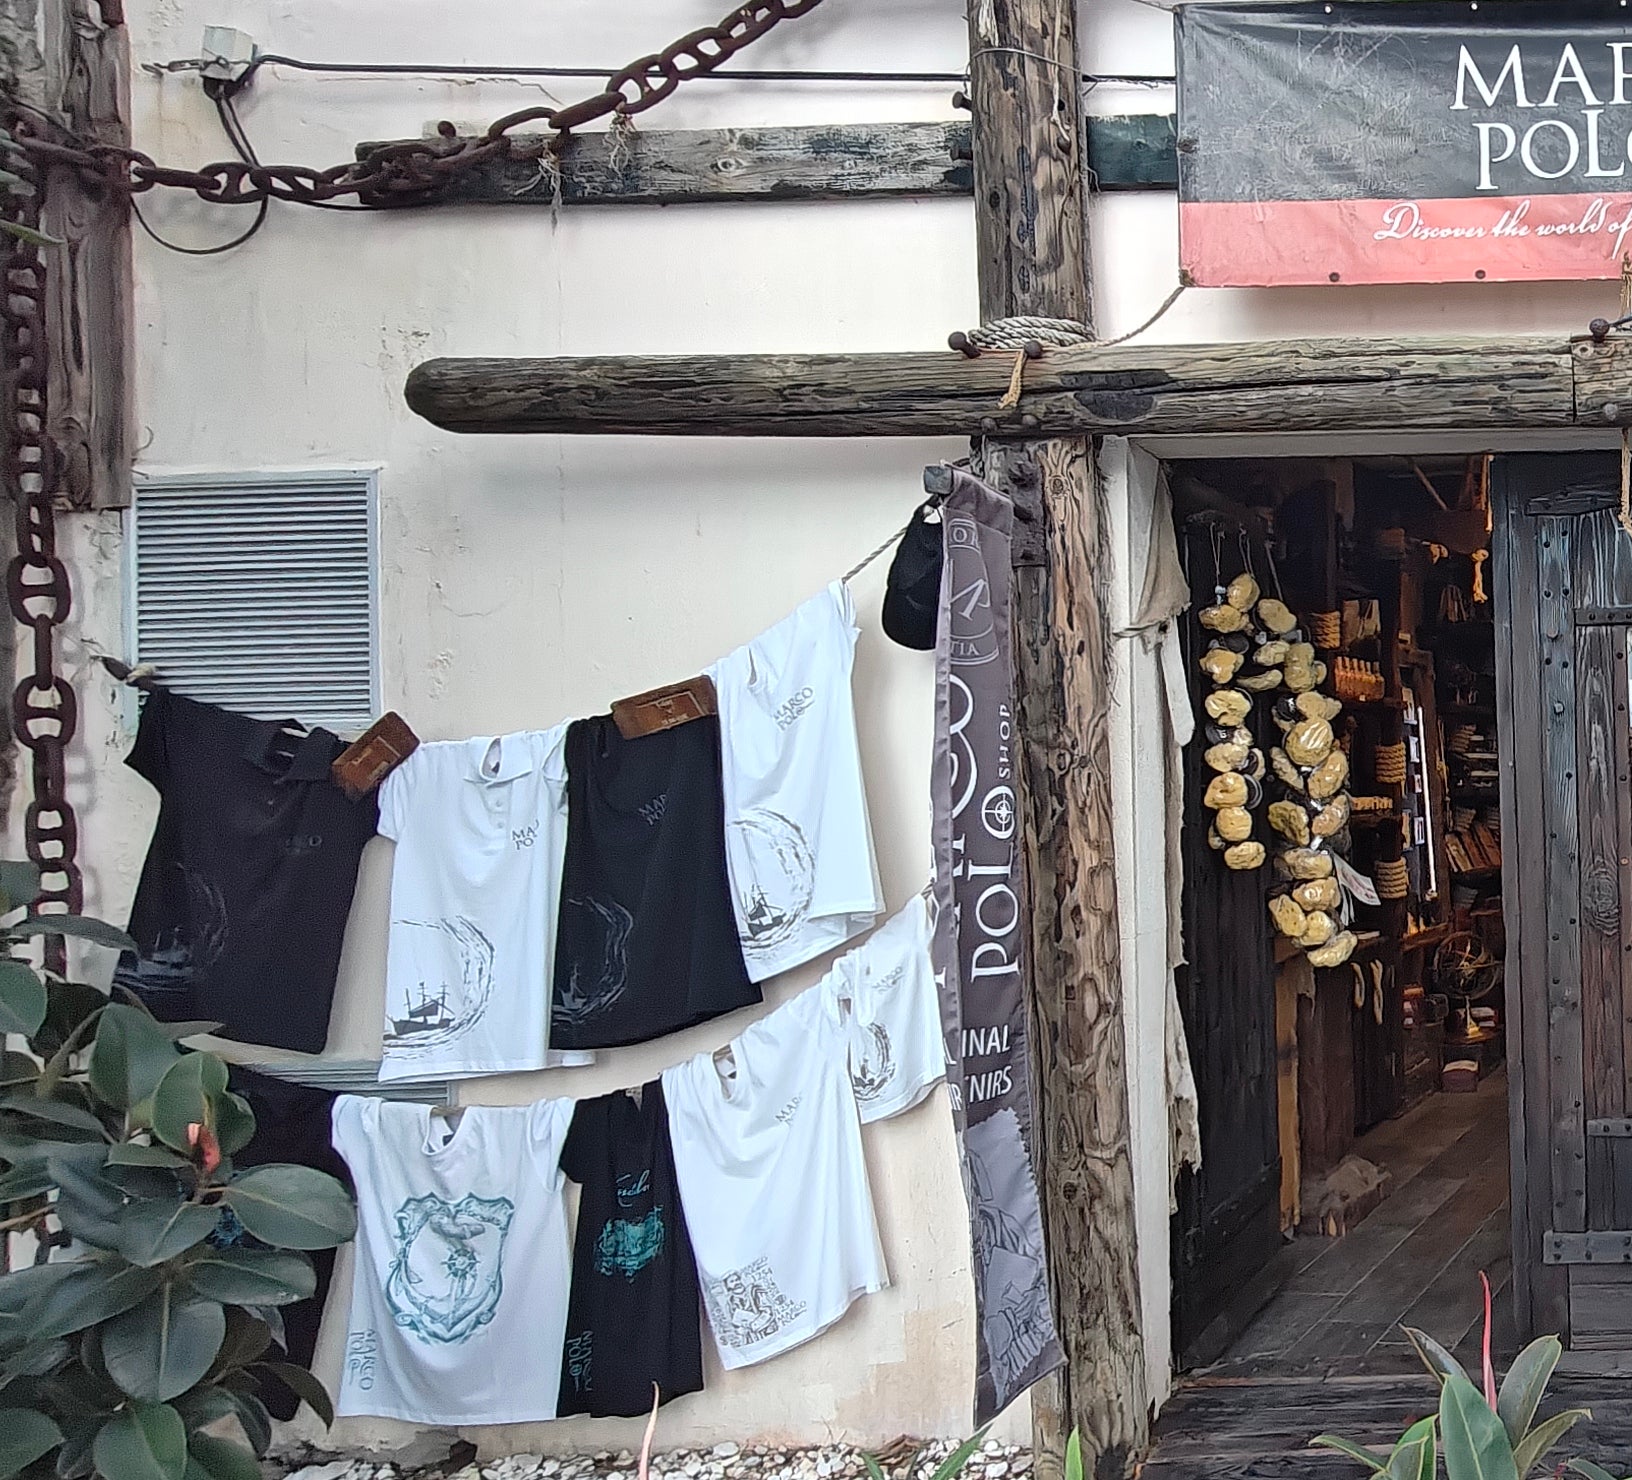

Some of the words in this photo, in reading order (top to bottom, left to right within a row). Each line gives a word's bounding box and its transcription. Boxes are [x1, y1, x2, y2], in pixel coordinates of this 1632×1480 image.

[1373, 202, 1485, 240] Discover
[1491, 199, 1531, 237] the
[1536, 198, 1613, 236] world
[970, 785, 1022, 983] POLO
[961, 1024, 1011, 1058] INAL
[964, 1065, 1013, 1103] NIRS
